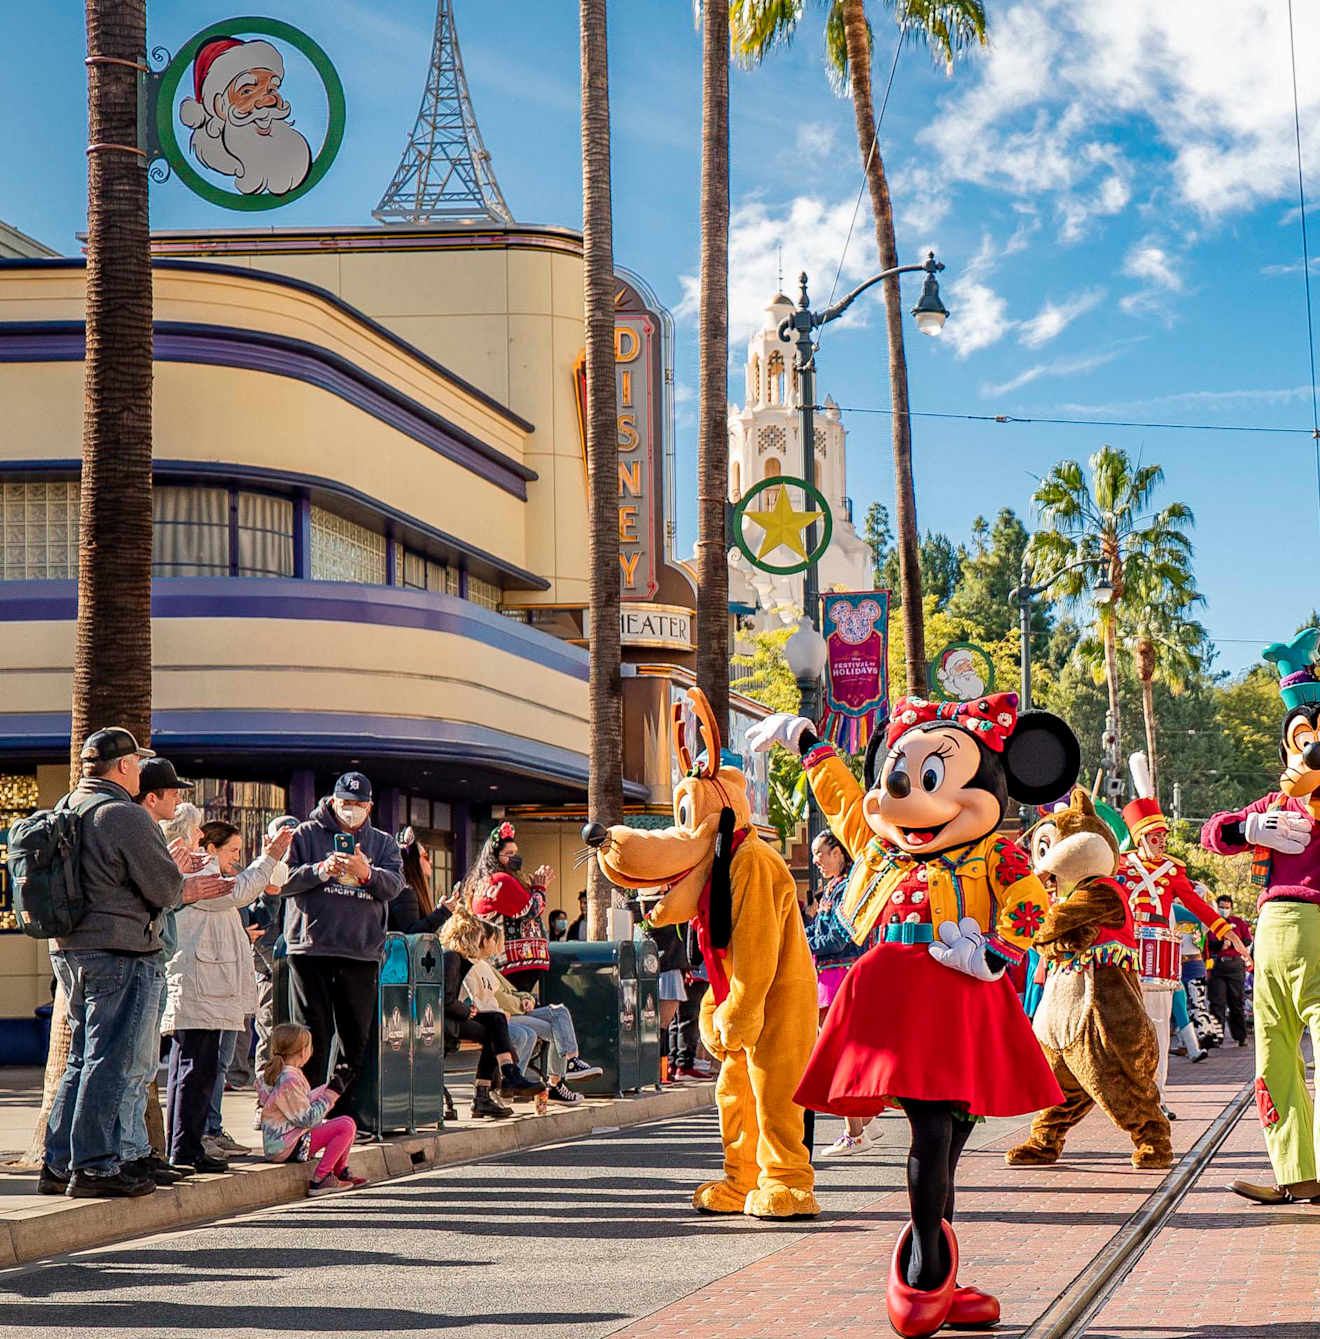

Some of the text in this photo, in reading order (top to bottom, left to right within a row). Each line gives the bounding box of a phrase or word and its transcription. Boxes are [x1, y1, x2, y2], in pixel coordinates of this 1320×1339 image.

[614, 326, 642, 589] DISNEY
[620, 614, 687, 640] EATER
[832, 666, 878, 677] HOLIDAYS
